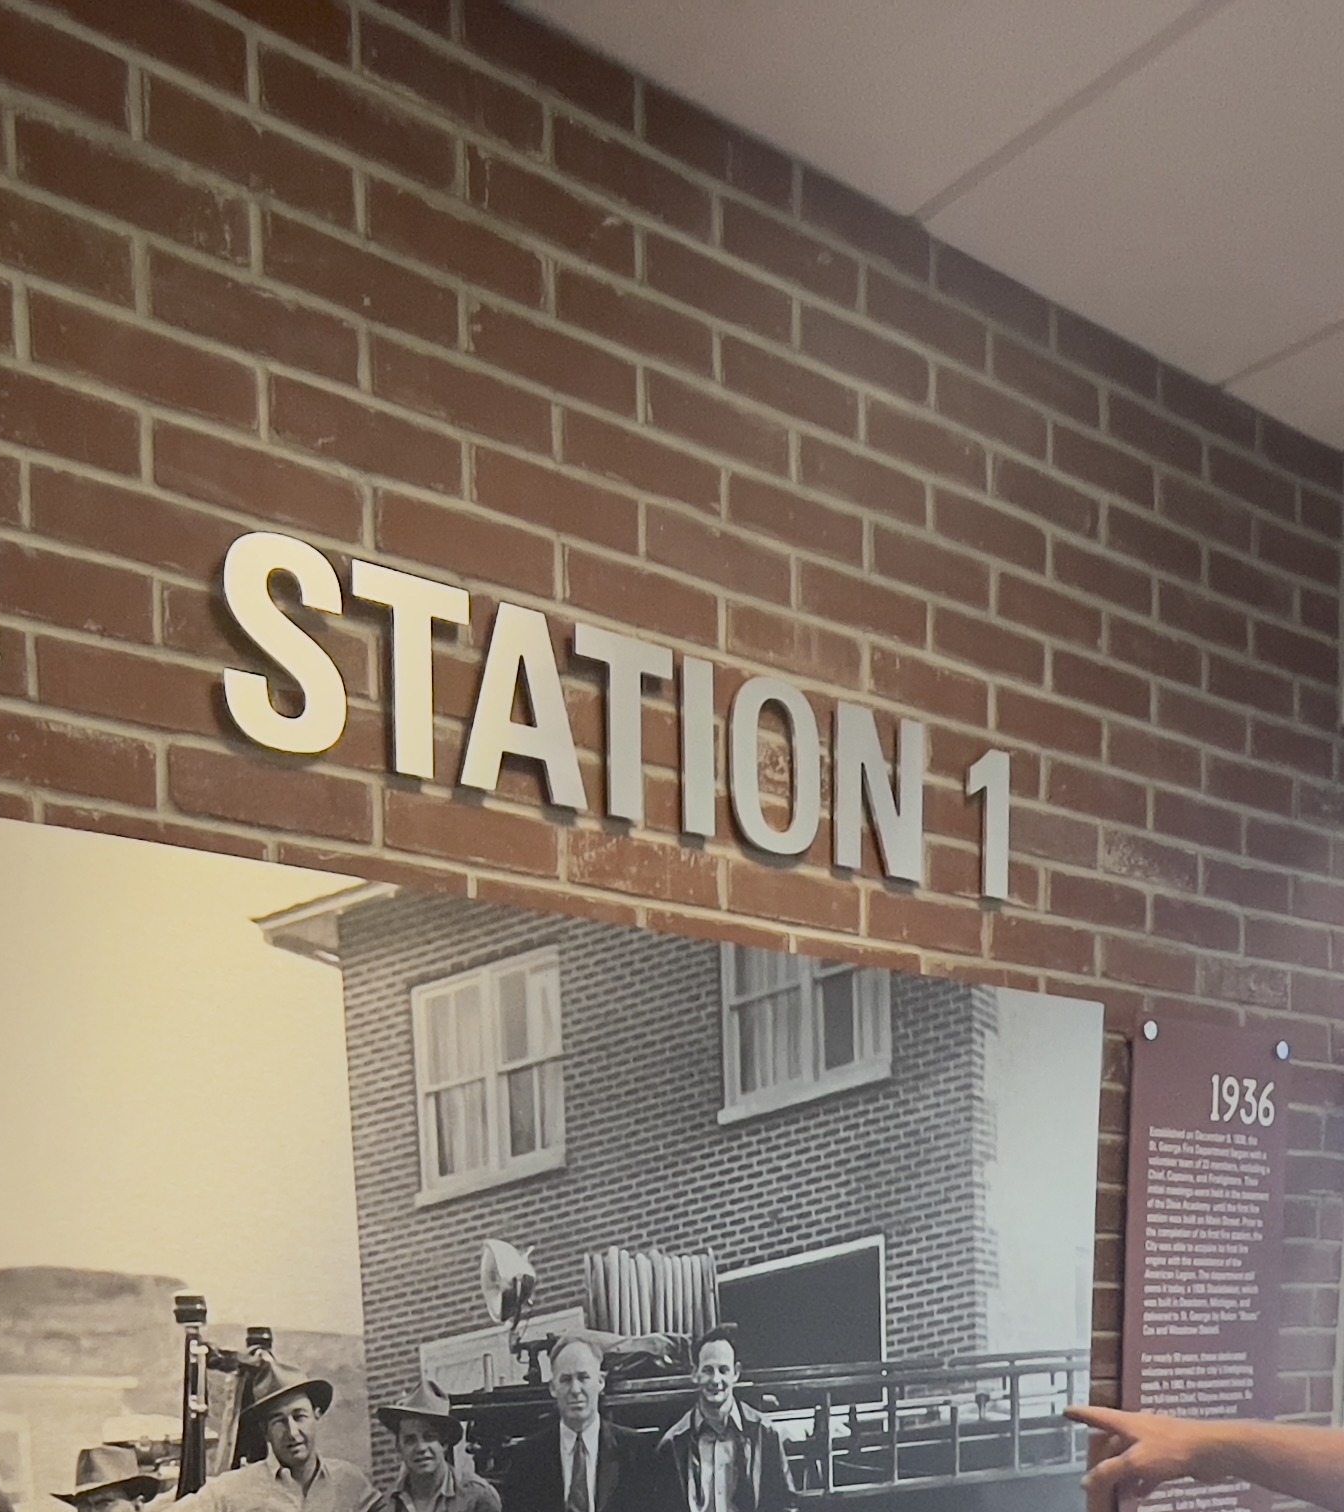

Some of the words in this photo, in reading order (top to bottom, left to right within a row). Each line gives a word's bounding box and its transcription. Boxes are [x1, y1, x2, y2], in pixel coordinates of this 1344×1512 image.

[223, 530, 925, 884] STATION
[966, 749, 1011, 899] 1
[1210, 1074, 1276, 1127] 1936
